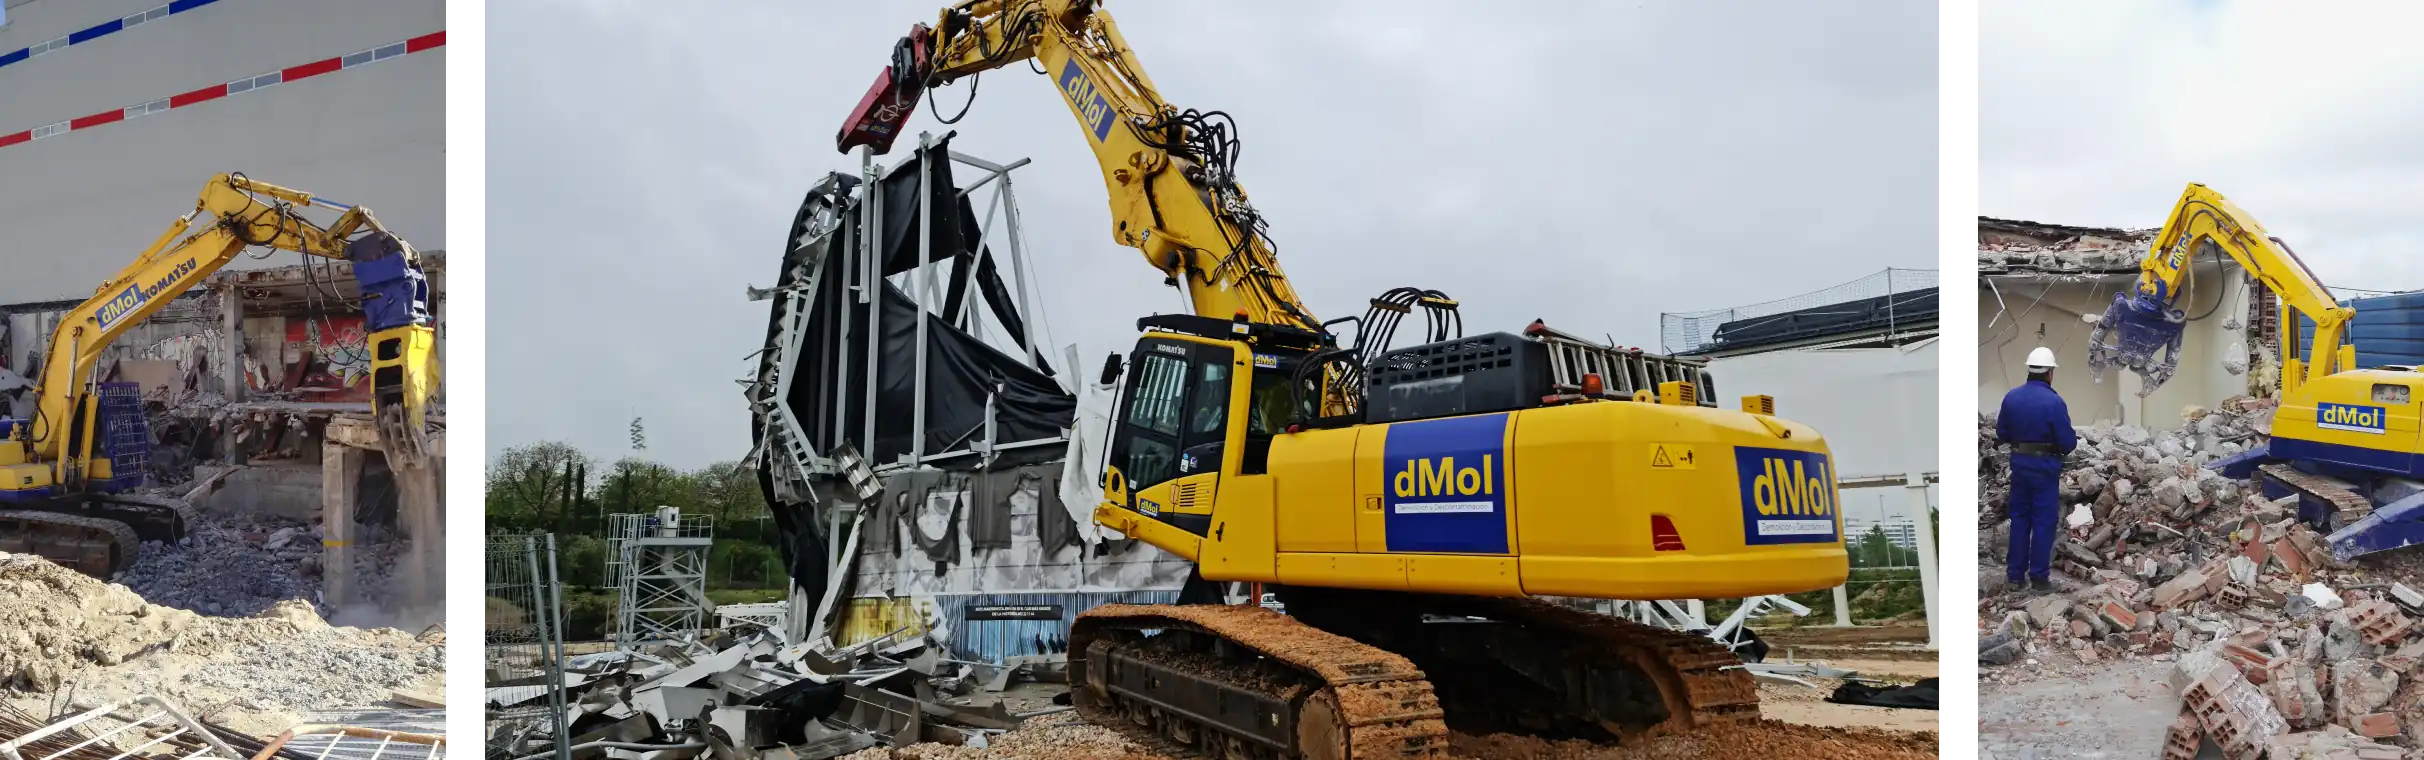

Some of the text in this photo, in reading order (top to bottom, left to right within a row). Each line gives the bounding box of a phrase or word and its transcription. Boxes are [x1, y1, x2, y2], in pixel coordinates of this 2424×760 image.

[1068, 73, 1107, 132] dMol
[141, 257, 197, 301] KOMATSU
[101, 287, 139, 324] dMol
[1157, 343, 1186, 356] KOMATSU
[1255, 354, 1277, 365] dMol
[2323, 405, 2379, 427] dMol
[1394, 453, 1493, 497] dMol
[1753, 457, 1831, 516] dMol
[1141, 501, 1158, 513] dMol
